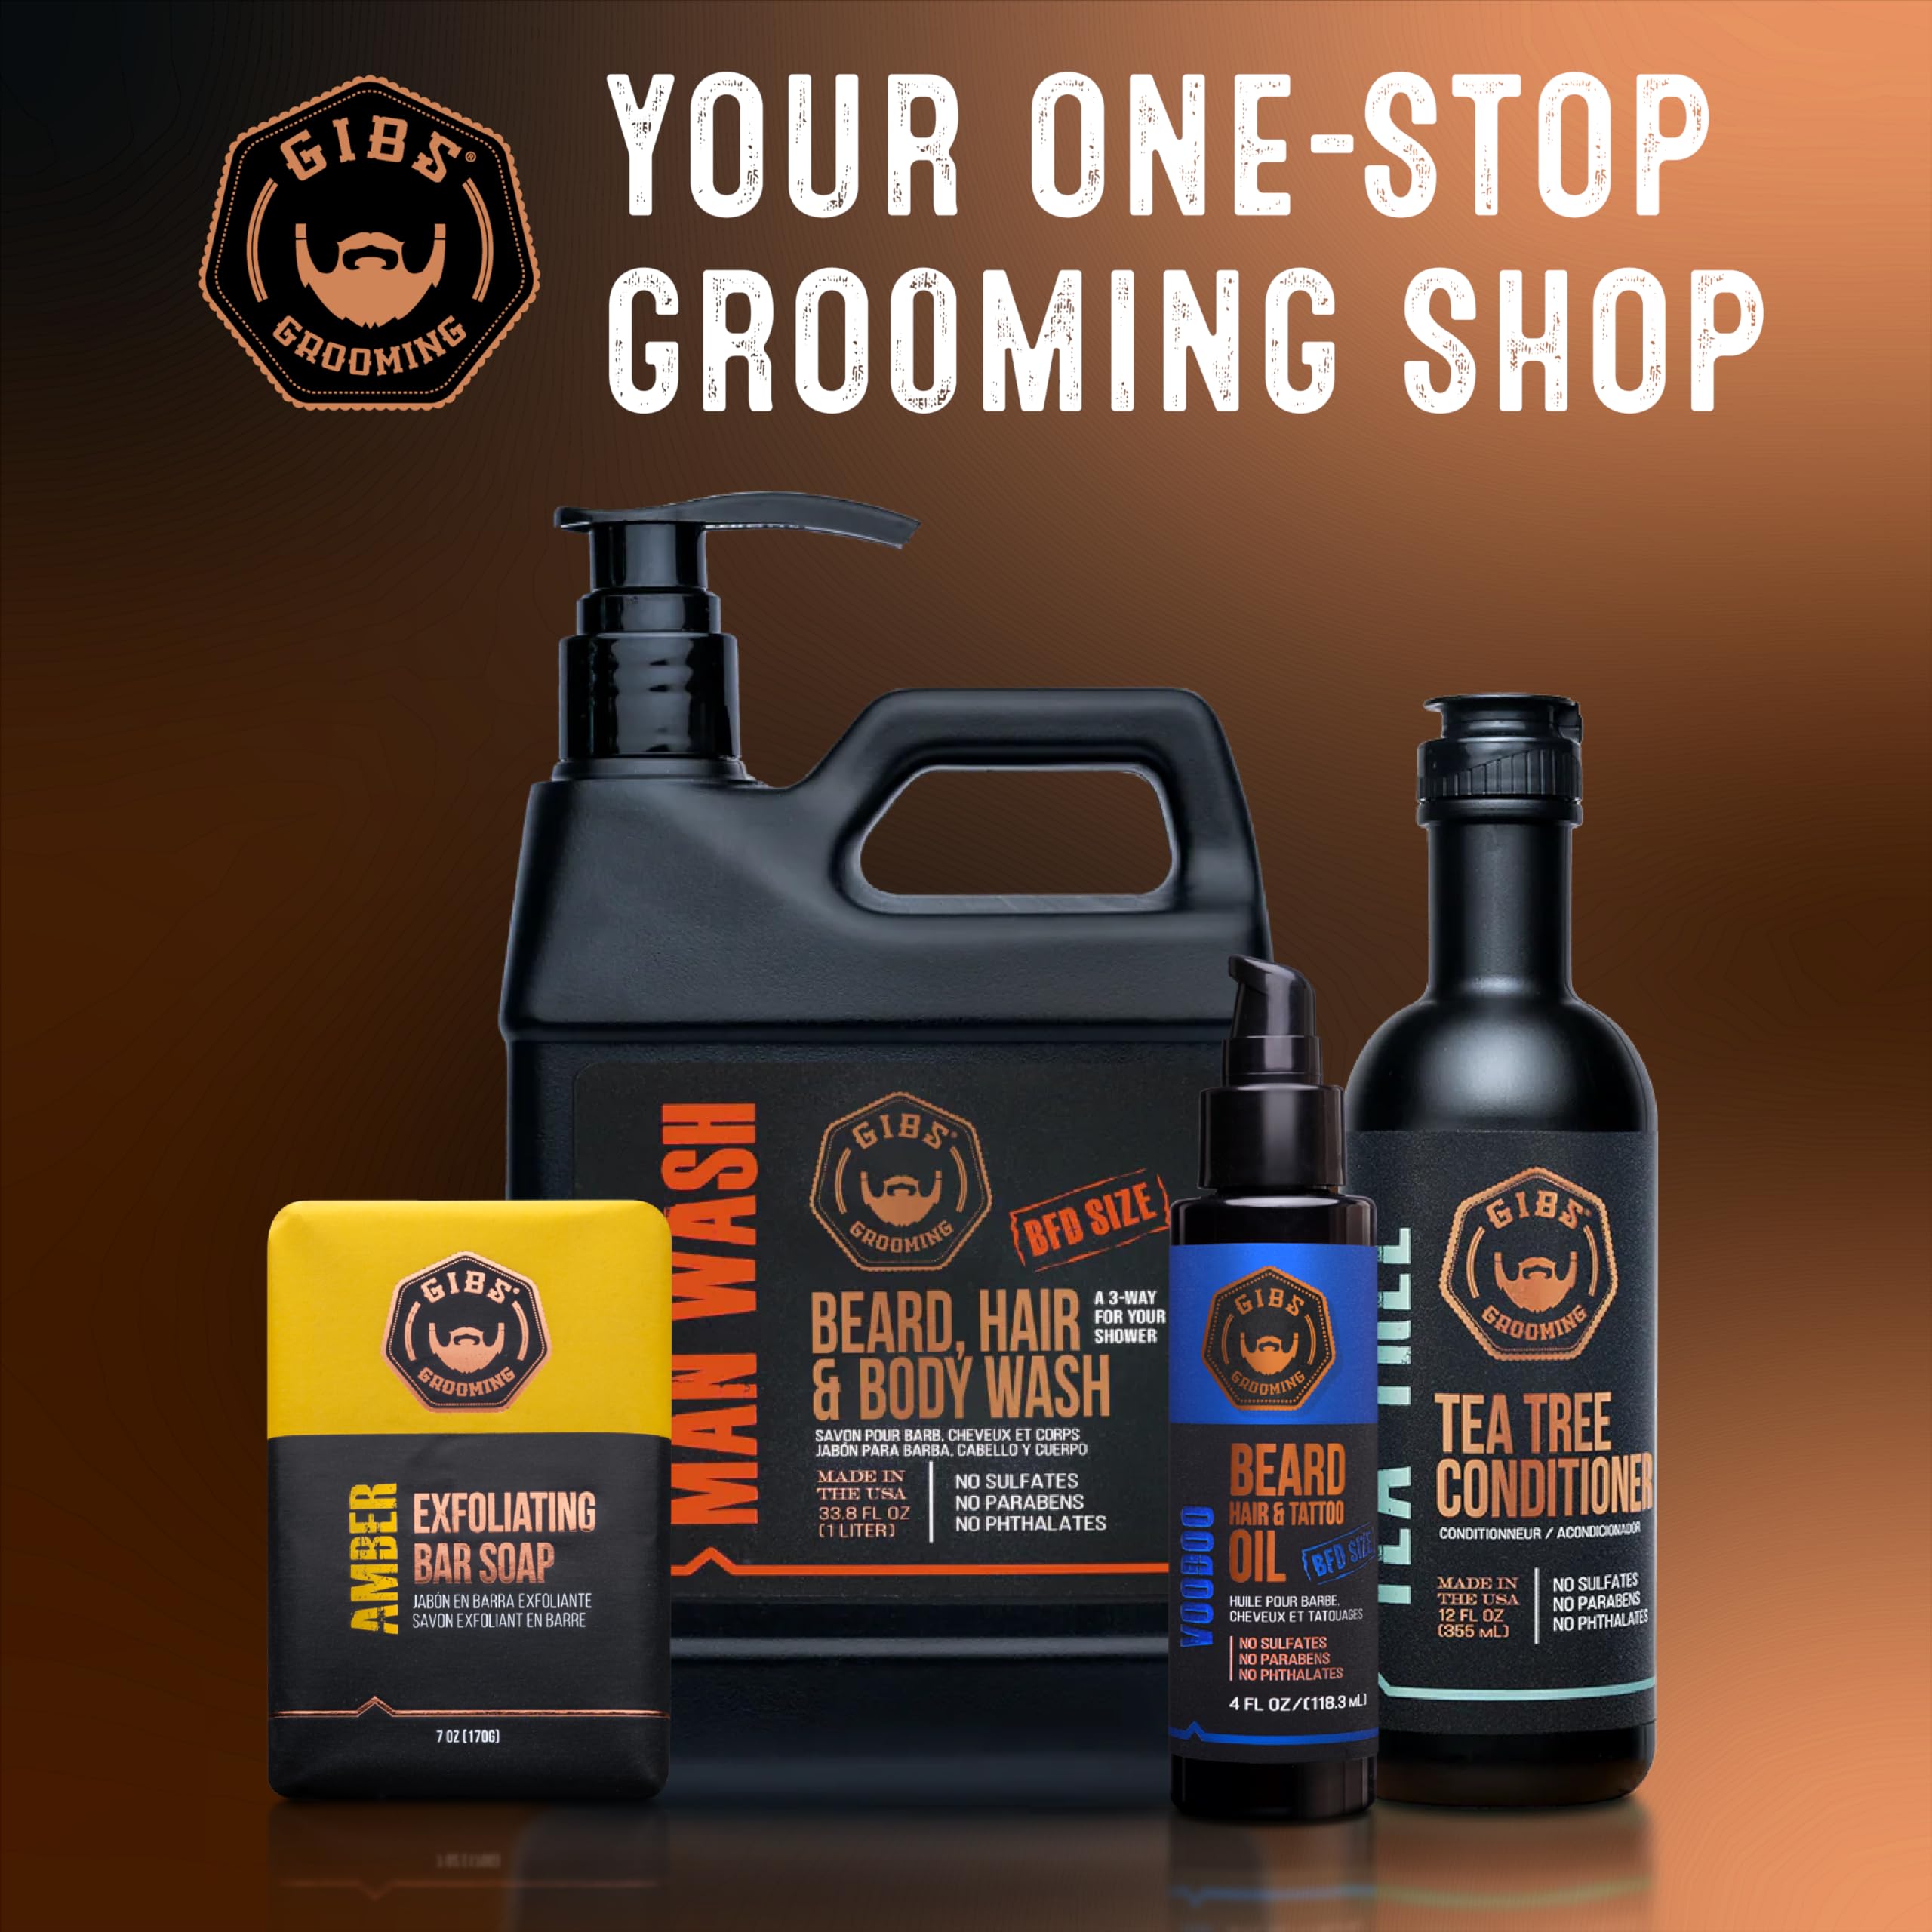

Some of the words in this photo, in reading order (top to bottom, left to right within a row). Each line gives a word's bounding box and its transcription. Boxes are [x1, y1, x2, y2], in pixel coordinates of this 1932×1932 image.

[660, 1103, 758, 1322] WASH
[1023, 1207, 1084, 1257] BFD
[1084, 1182, 1158, 1236] SIZE
[849, 1220, 954, 1254] GROOMING
[1094, 1291, 1104, 1305] A
[1109, 1291, 1157, 1305] 3-WAY
[1234, 1287, 1305, 1317] GIBS
[811, 1289, 965, 1360] BEARD,
[980, 1288, 1081, 1353] HAIR
[1094, 1309, 1123, 1324] FOR
[1128, 1309, 1167, 1324] YOUR
[1481, 1304, 1588, 1341] GROOMING
[1094, 1328, 1158, 1344] SHOWER
[417, 1366, 515, 1398] GROOMING
[812, 1358, 841, 1421] &
[860, 1355, 974, 1420] BODY
[984, 1354, 1111, 1419] WASH
[1230, 1370, 1306, 1396] GROOMING
[1434, 1392, 1514, 1454] TEA
[1523, 1392, 1612, 1454] TREE
[670, 1353, 758, 1524] MAN
[815, 1429, 861, 1442] SAVON
[865, 1429, 901, 1442] POUR
[948, 1428, 1011, 1442] CHEVEUX
[1015, 1428, 1033, 1441] ET
[1035, 1428, 1081, 1441] CORPS
[815, 1442, 859, 1457] JABÓN
[863, 1444, 900, 1457] PARA
[957, 1443, 1018, 1457] CABELLO
[1023, 1443, 1031, 1457] Y
[1035, 1443, 1088, 1457] CUERPO
[817, 1470, 877, 1483] MADE
[881, 1470, 906, 1483] IN
[1229, 1442, 1346, 1497] BEARD
[955, 1473, 980, 1490] NO
[985, 1472, 1079, 1490] SULFATES
[1436, 1451, 1654, 1519] CONDITIONER
[816, 1487, 861, 1500] THE
[866, 1487, 908, 1500] USA
[955, 1494, 980, 1511] NO
[985, 1494, 1084, 1511] PARABENS
[413, 1491, 596, 1534] EXFOLIATING
[863, 1506, 883, 1521] FL
[887, 1506, 911, 1521] OZ
[1229, 1500, 1270, 1526] HAIR
[1273, 1502, 1286, 1527] &
[1289, 1500, 1345, 1526] TATTOO
[818, 1523, 834, 1538] (1
[838, 1523, 896, 1538] LITER)
[955, 1516, 980, 1532] NO
[985, 1515, 1108, 1532] PHTHALATES
[1439, 1527, 1542, 1540] CONDITIONNEUR
[1545, 1527, 1554, 1540] /
[349, 1483, 399, 1635] AMBER
[413, 1542, 473, 1585] BAR
[479, 1542, 555, 1584] SOAP
[1229, 1528, 1287, 1583] OIL
[1312, 1543, 1346, 1577] BFD
[1180, 1505, 1214, 1647] VOODOO
[1437, 1577, 1492, 1589] MADE
[1496, 1577, 1521, 1589] IN
[1552, 1577, 1574, 1592] NO
[1577, 1571, 1640, 1592] SULFATES
[412, 1592, 451, 1609] JABÓN
[454, 1594, 469, 1609] EN
[472, 1593, 515, 1609] BARRA
[518, 1592, 592, 1609] EXFOLIANTE
[1229, 1595, 1263, 1607] HUILE
[1265, 1595, 1298, 1607] POUR
[1437, 1593, 1478, 1606] THE
[1481, 1593, 1521, 1606] USA
[1552, 1596, 1574, 1613] NO
[1577, 1590, 1641, 1612] PARABENS
[412, 1613, 453, 1629] SAVON
[457, 1612, 523, 1629] EXFOLIANT
[526, 1612, 543, 1628] EN
[546, 1612, 586, 1628] BARRE
[1229, 1610, 1286, 1623] CHEVEUX
[1289, 1610, 1305, 1623] ET
[1308, 1608, 1364, 1623] TATOUAGES
[1438, 1608, 1456, 1623] 12
[1460, 1608, 1478, 1623] FL
[1482, 1608, 1505, 1623] OZ
[1552, 1617, 1574, 1632] NO
[1577, 1608, 1649, 1632] PHTHALATES
[1437, 1624, 1475, 1638] (355
[1239, 1637, 1258, 1650] NO
[1260, 1636, 1327, 1650] SULFATES
[1239, 1653, 1257, 1665] NO
[1260, 1651, 1331, 1665] PARABENS
[1239, 1669, 1257, 1681] NO
[1260, 1667, 1344, 1681] PHTHALATES
[1229, 1697, 1240, 1711] 4
[1244, 1697, 1264, 1712] FL
[435, 1729, 444, 1743] 7
[446, 1729, 460, 1743] OZ
[463, 1728, 500, 1744] (170G)
